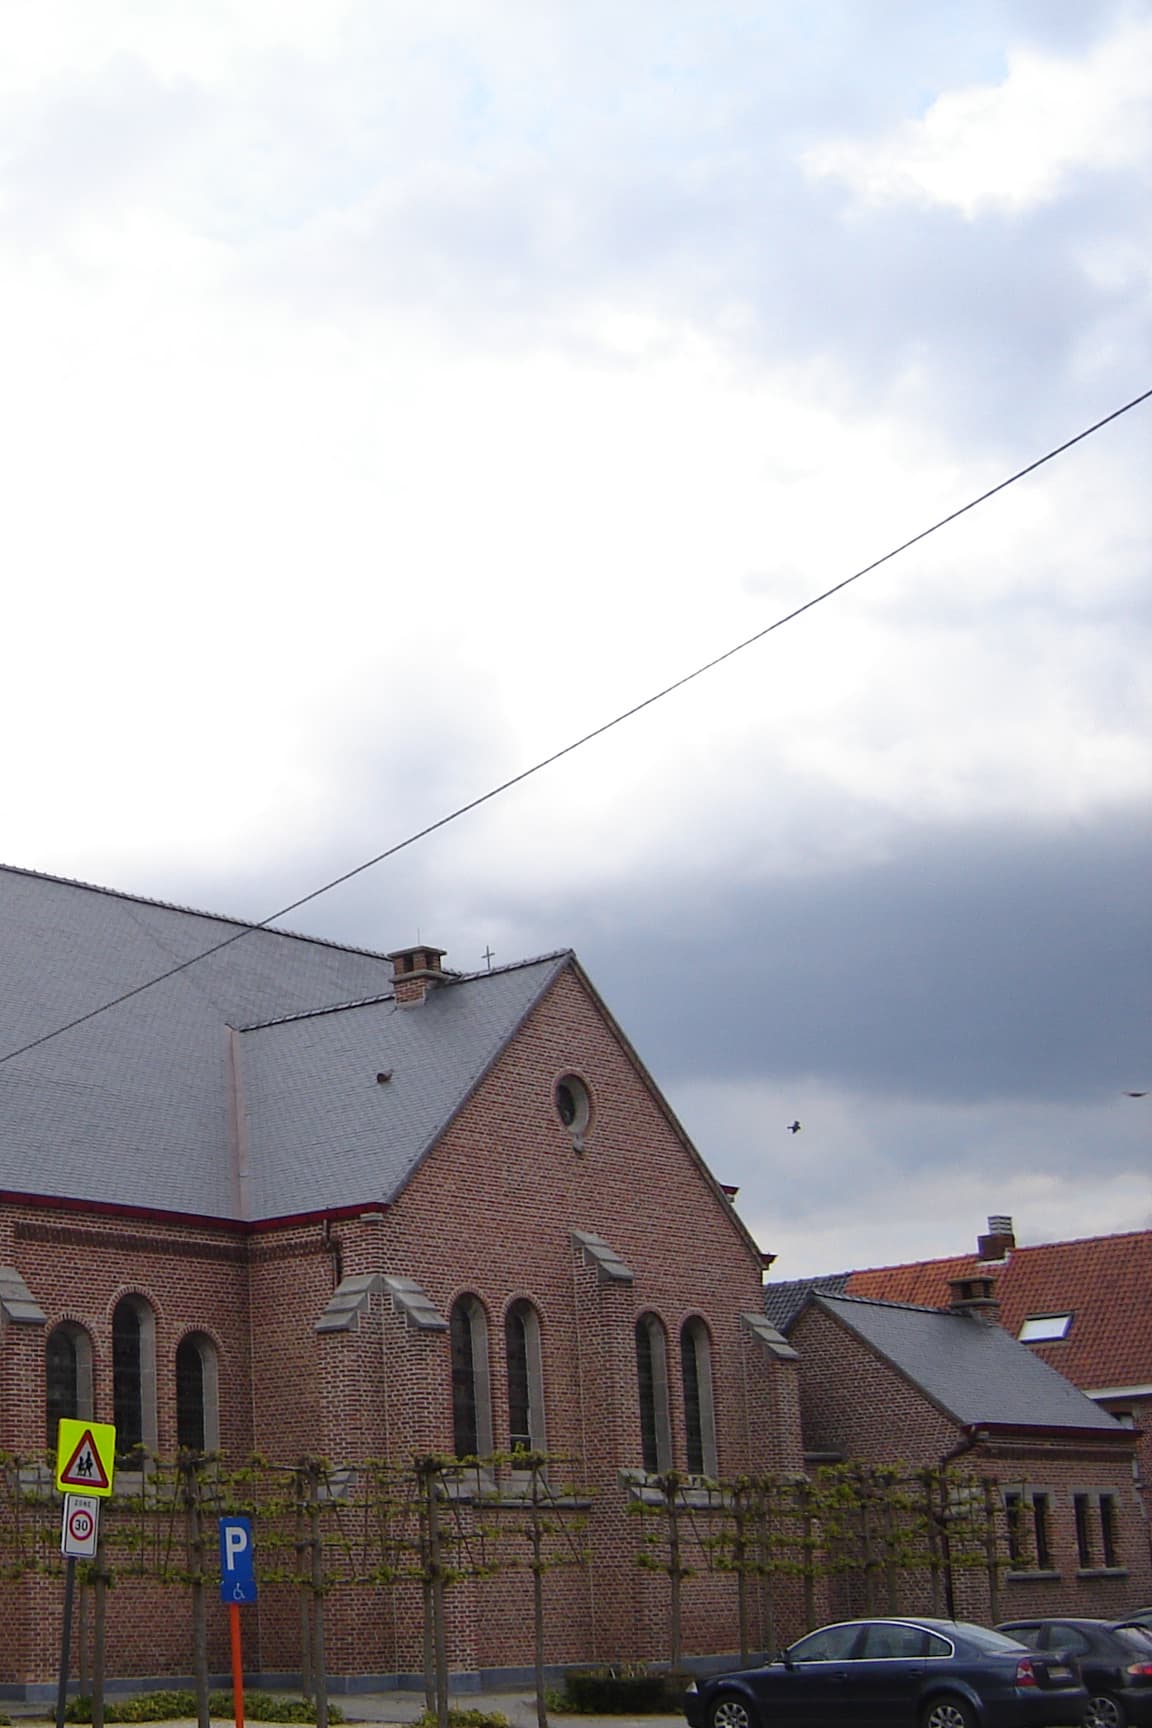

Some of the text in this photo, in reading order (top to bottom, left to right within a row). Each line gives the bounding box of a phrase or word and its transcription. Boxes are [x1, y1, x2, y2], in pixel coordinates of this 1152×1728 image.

[74, 1499, 91, 1507] ZONE
[74, 1519, 88, 1531] 30
[225, 1526, 248, 1571] P
